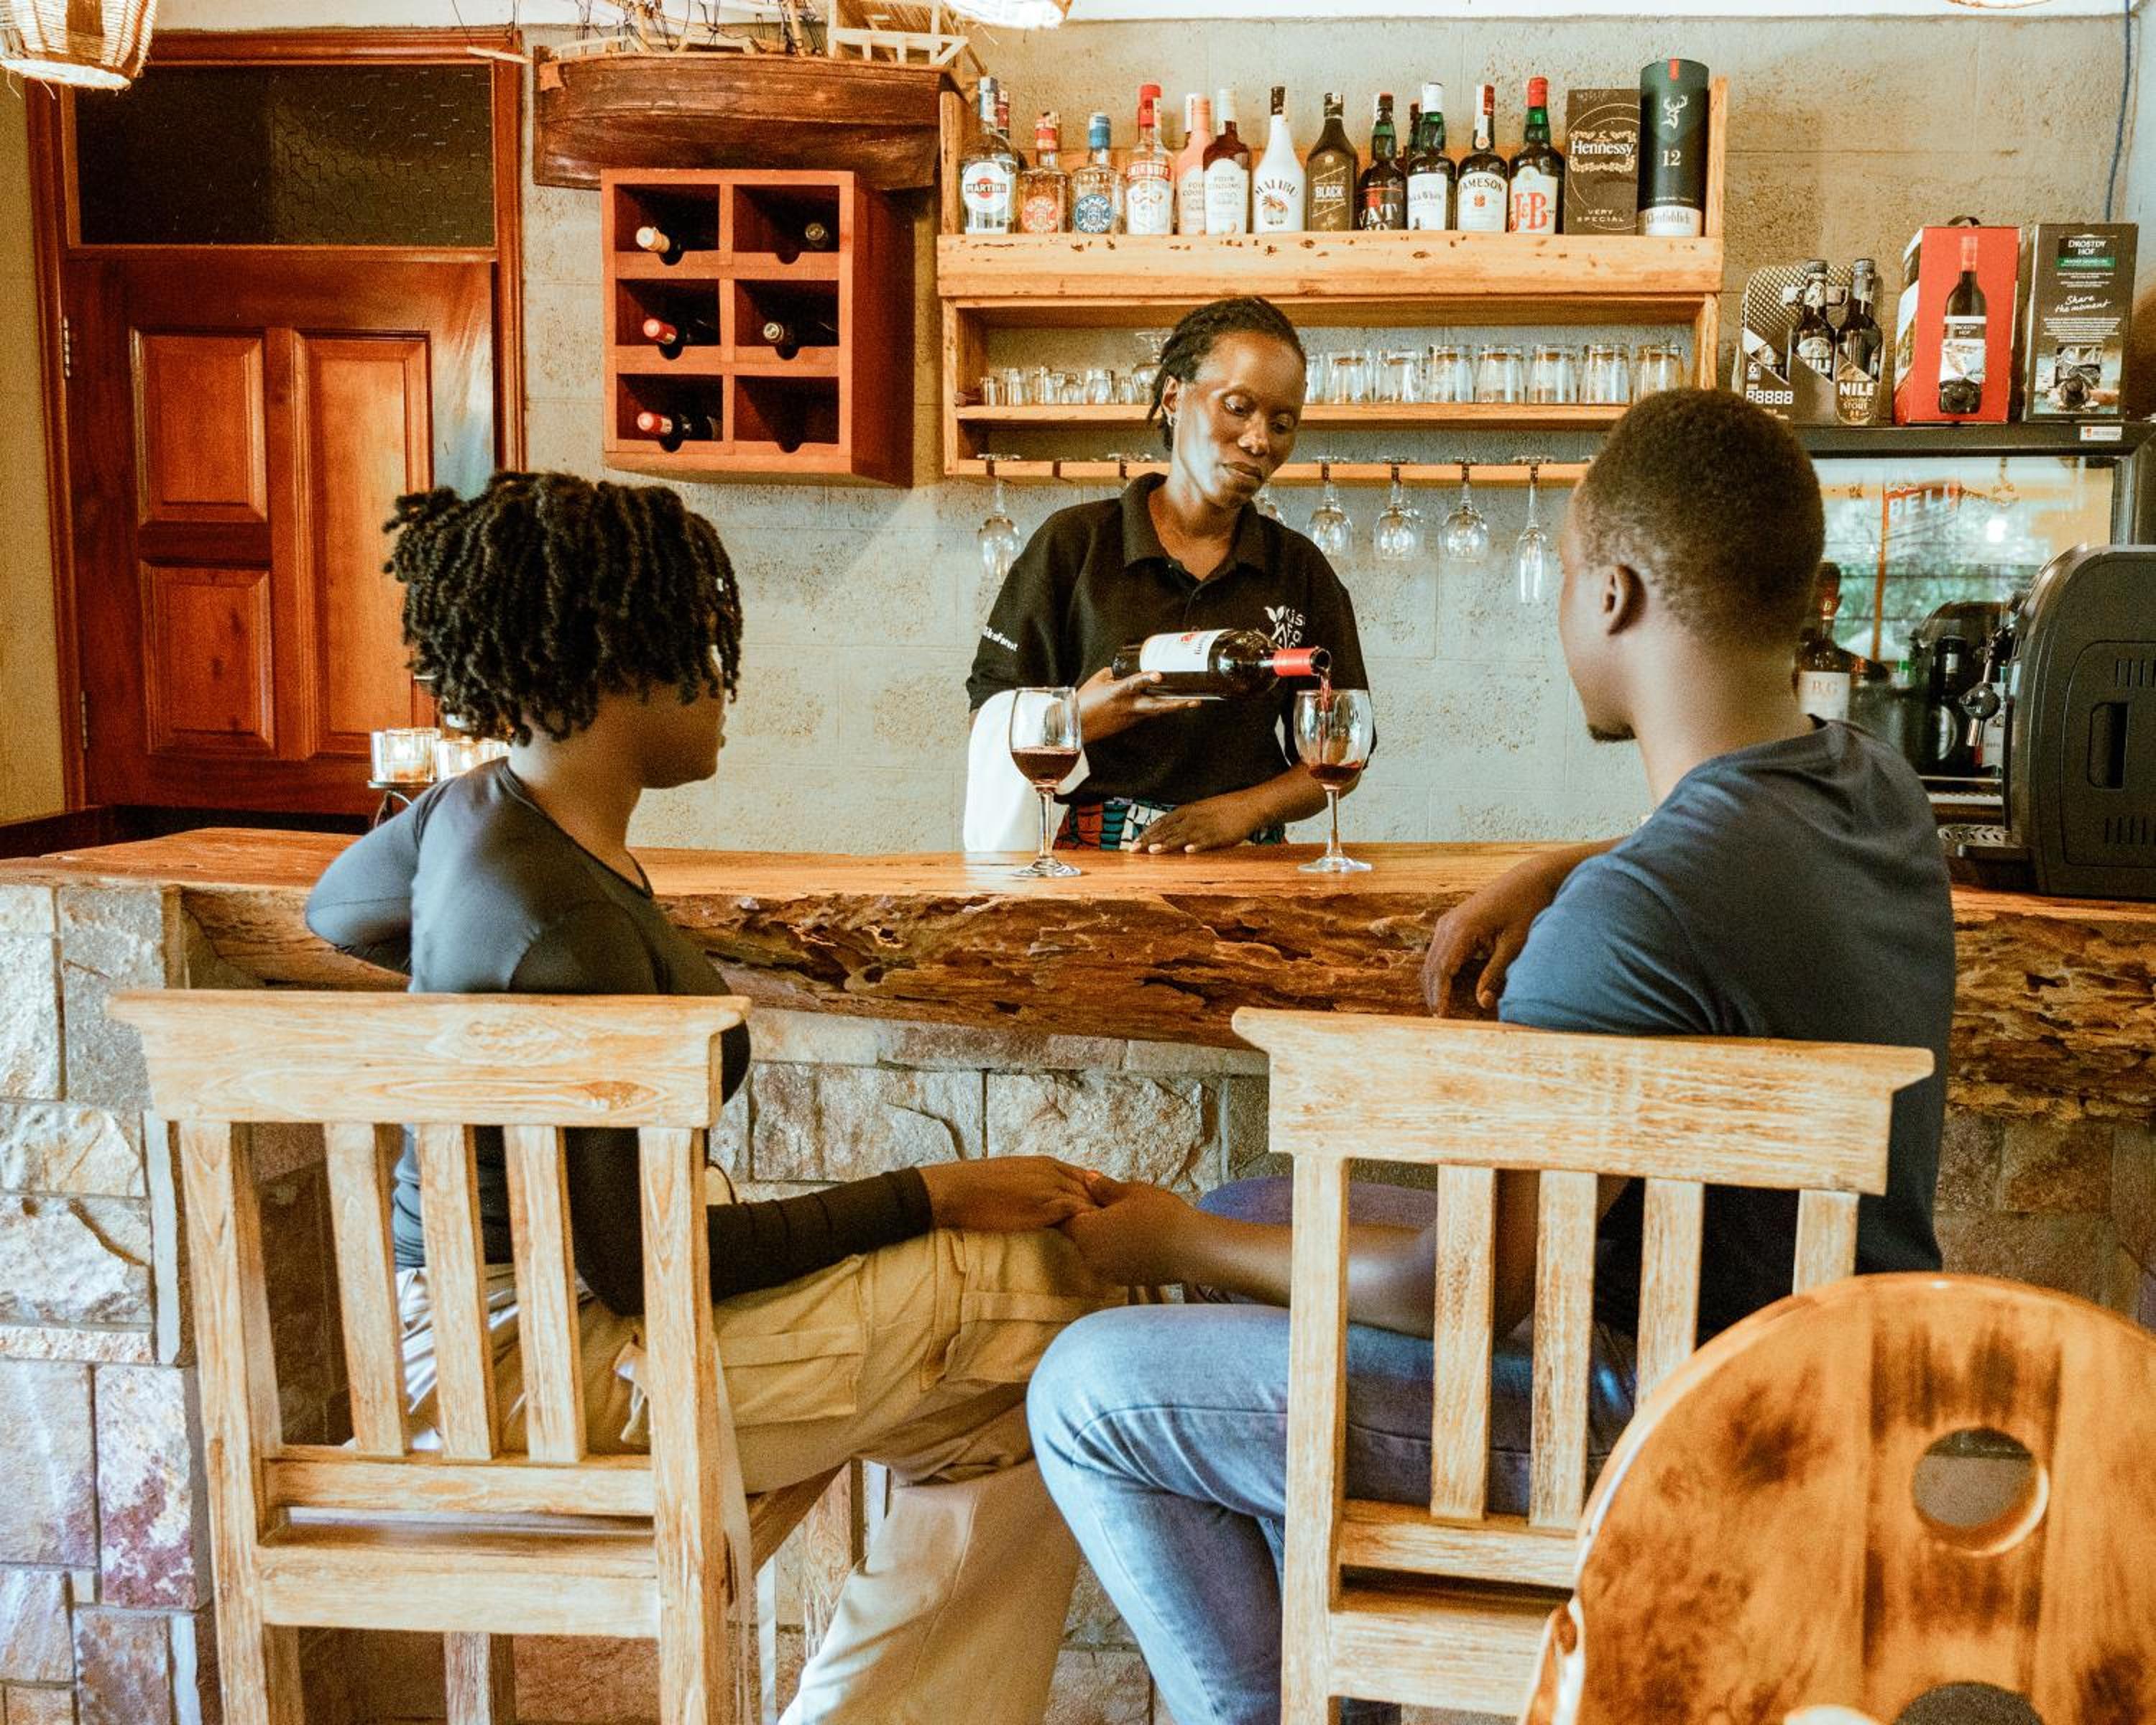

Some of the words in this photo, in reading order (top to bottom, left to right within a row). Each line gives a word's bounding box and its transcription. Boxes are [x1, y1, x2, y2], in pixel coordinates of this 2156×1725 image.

[1572, 140, 1634, 156] Hennessy
[1663, 150, 1681, 167] 12
[1315, 185, 1343, 198] BLACK
[1459, 178, 1503, 195] JAMESON
[1359, 203, 1398, 228] VAT
[2055, 304, 2070, 313] the
[2070, 298, 2112, 311] moment
[2065, 295, 2094, 305] Share
[1839, 382, 1874, 396] NILE
